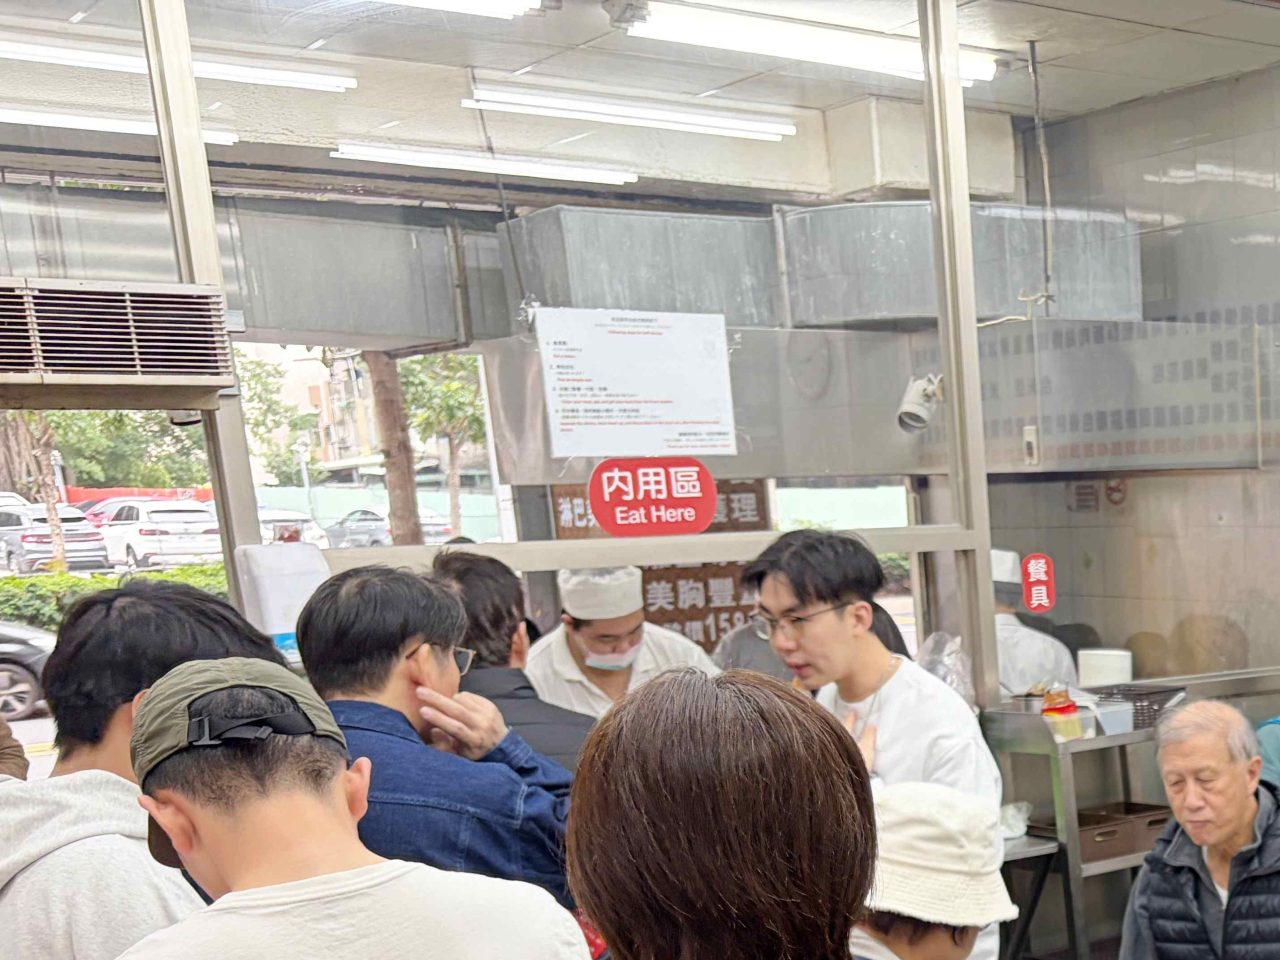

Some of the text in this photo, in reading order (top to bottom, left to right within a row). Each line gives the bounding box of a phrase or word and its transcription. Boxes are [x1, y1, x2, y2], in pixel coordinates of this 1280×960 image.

[614, 504, 696, 525] Eat Here
[1027, 559, 1050, 608] 餐具
